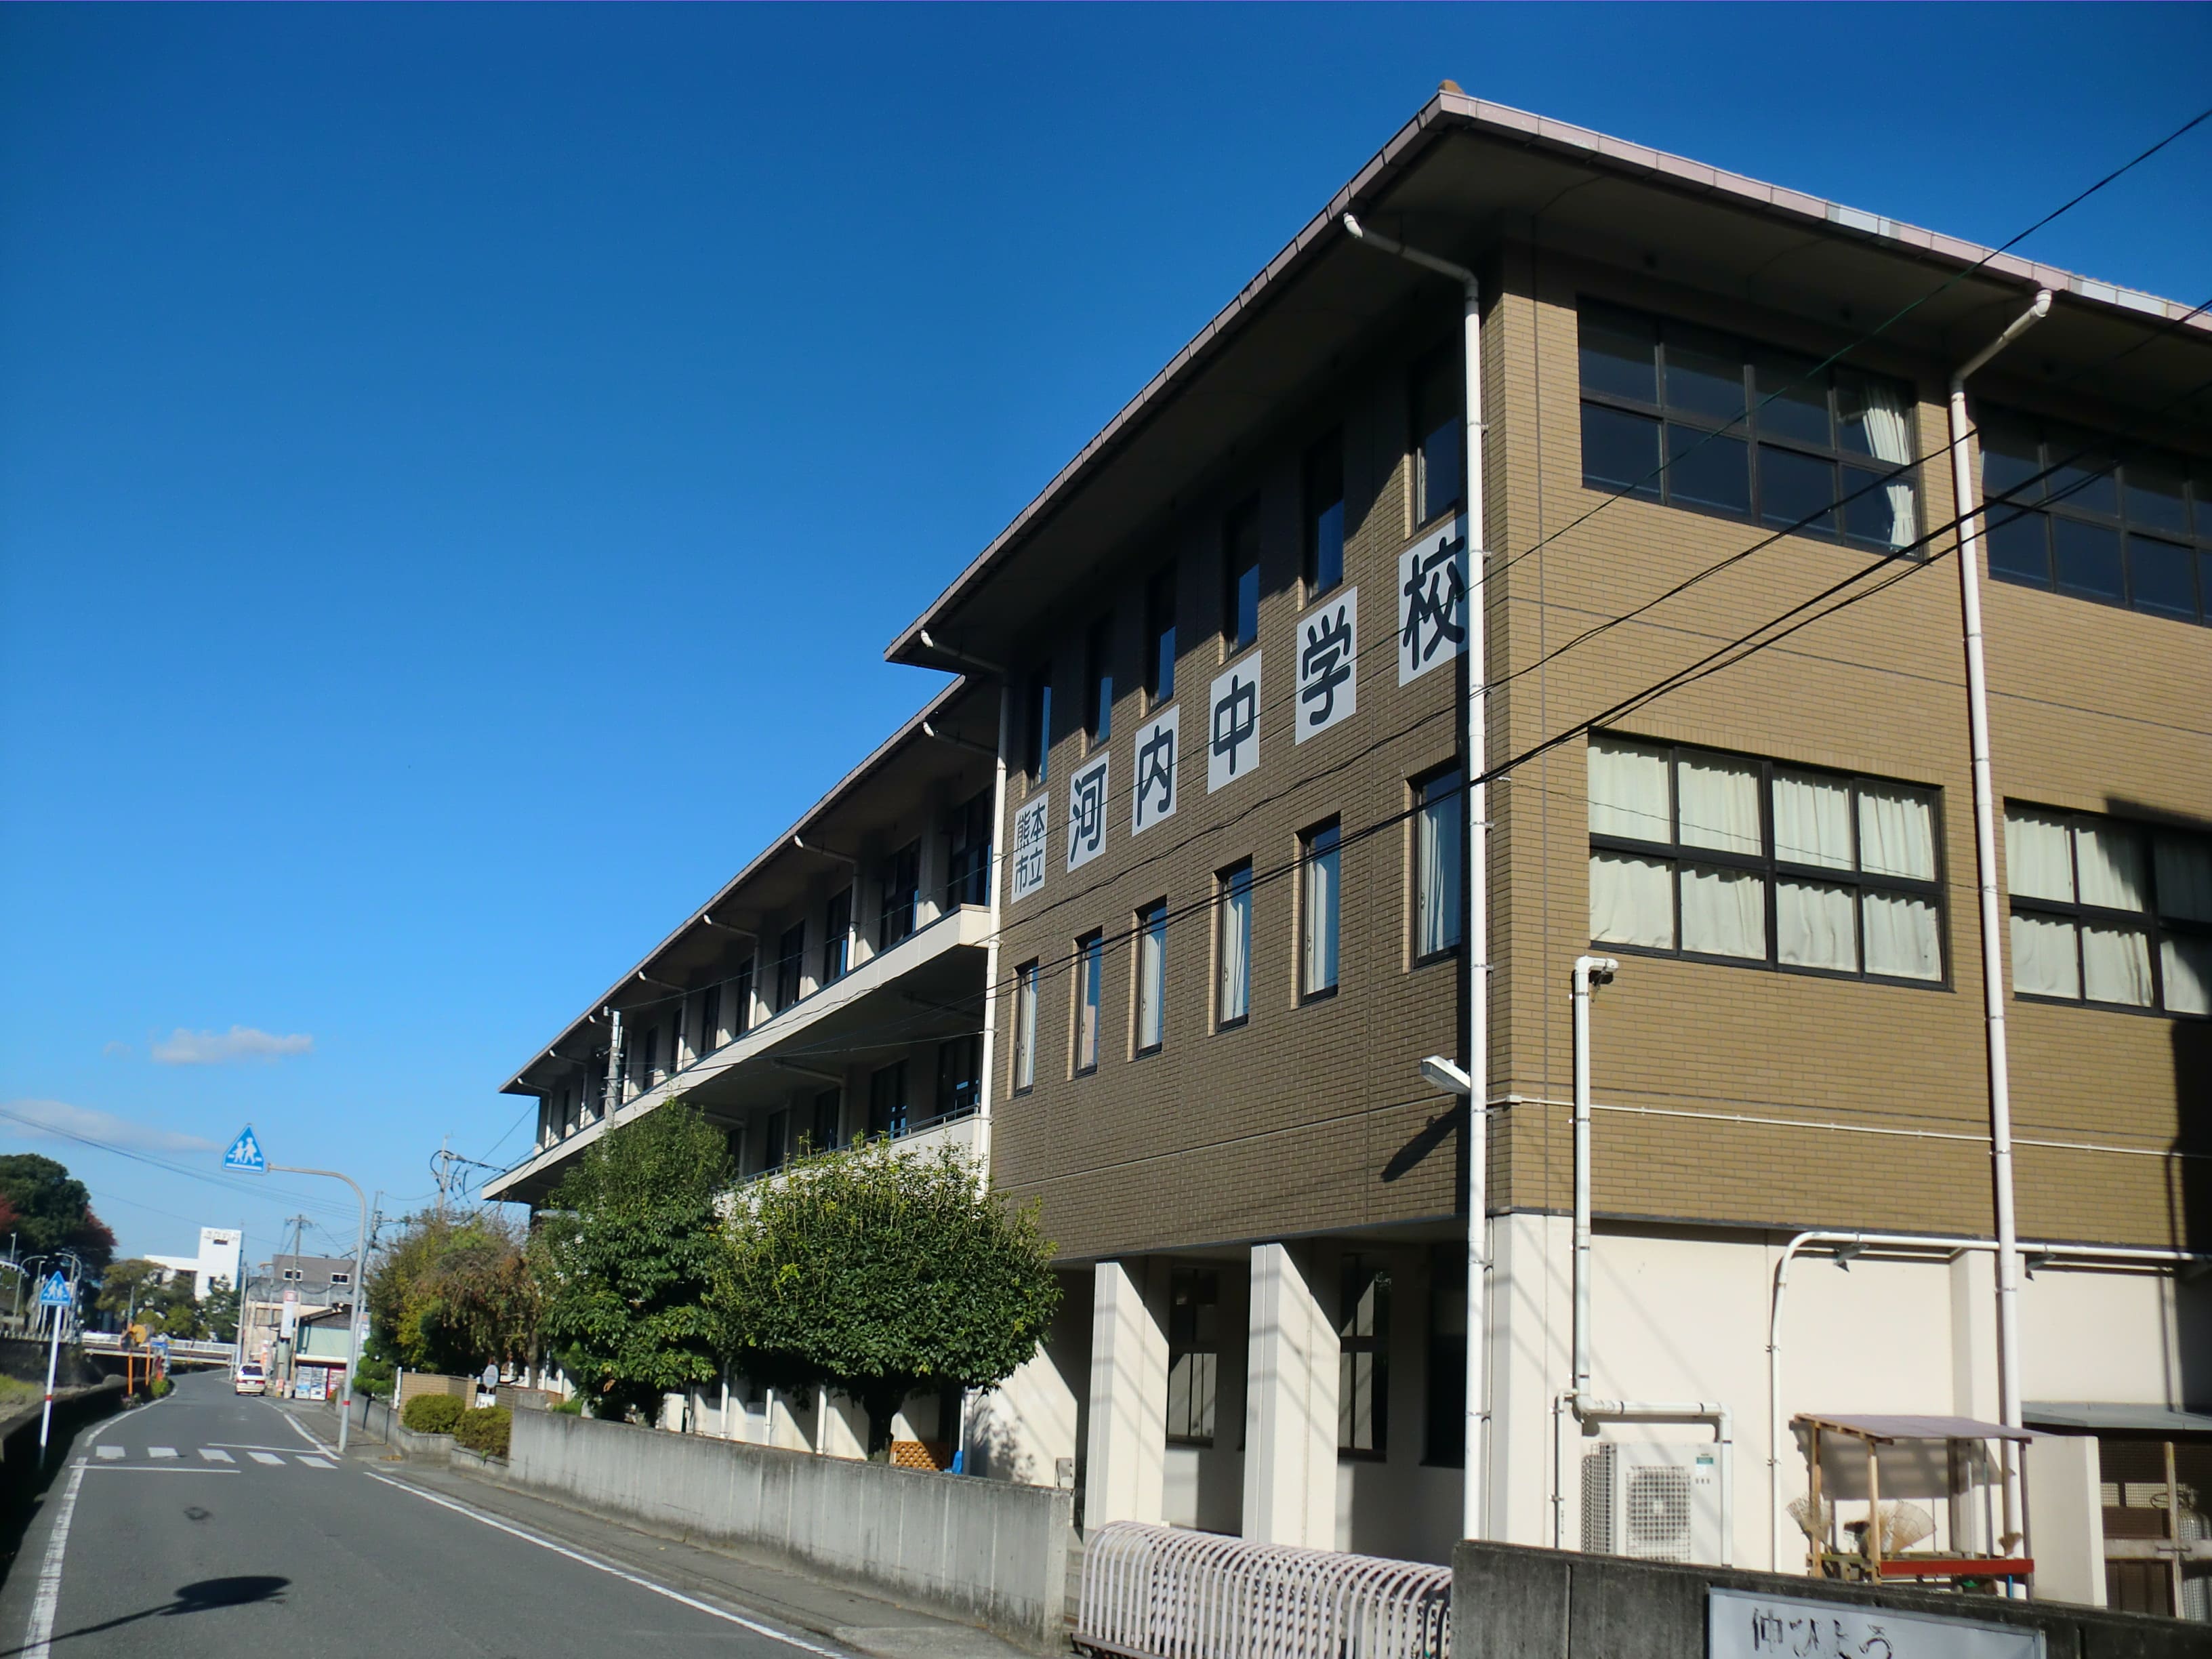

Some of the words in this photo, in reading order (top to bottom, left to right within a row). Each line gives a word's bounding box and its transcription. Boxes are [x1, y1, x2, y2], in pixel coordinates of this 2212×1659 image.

[1070, 536, 1466, 863] 河内中学校
[1017, 802, 1046, 851] 熊本
[1015, 846, 1043, 893] 市立
